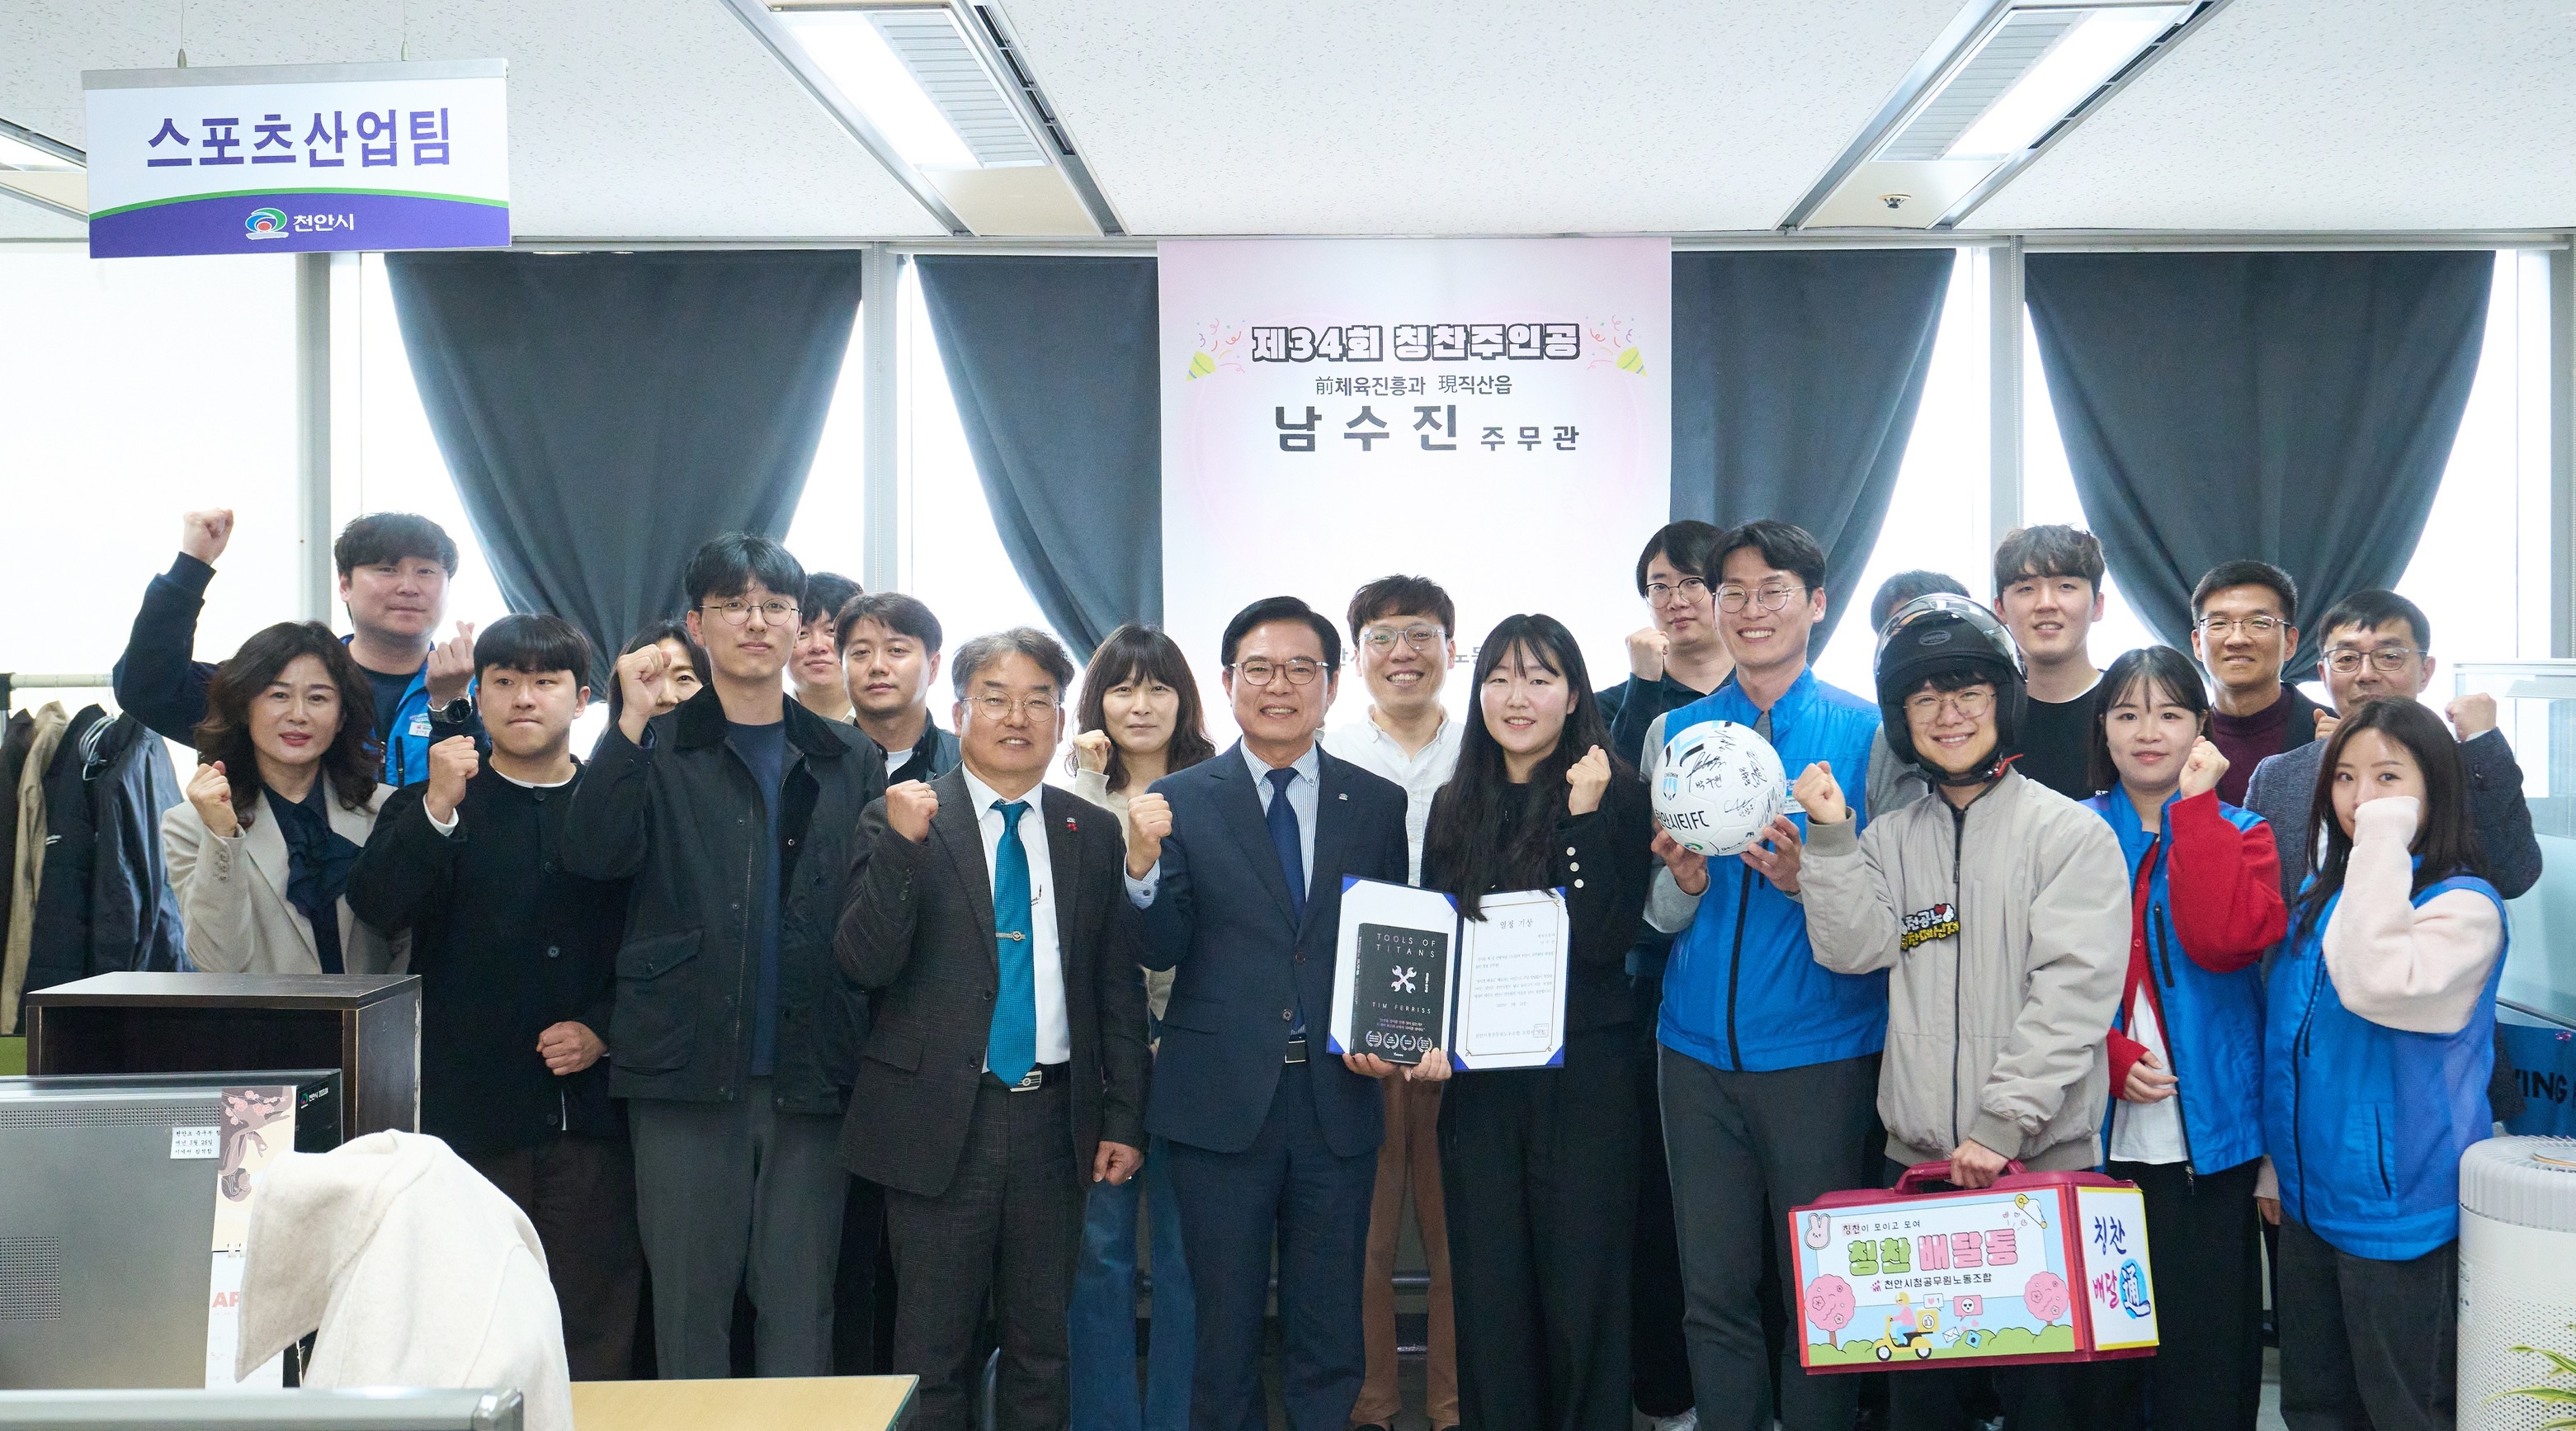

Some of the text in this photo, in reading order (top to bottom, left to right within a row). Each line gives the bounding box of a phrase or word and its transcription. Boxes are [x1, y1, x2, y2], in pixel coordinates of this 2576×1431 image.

[147, 108, 450, 168] 스포츠산업팀
[293, 213, 355, 234] 천안시
[1252, 323, 1581, 362] 제34회 칭찬주인공
[1315, 375, 1513, 397] 前체육진흥과 現직산읍
[1376, 933, 1436, 947] TOOLS OF
[1376, 943, 1435, 958] TITANS
[1394, 1004, 1432, 1014] FERRISS
[2515, 1069, 2568, 1104] ING
[1842, 1220, 1921, 1235] 칭찬이 모이고 모여
[2094, 1216, 2127, 1255] 칭찬
[1847, 1228, 2019, 1277] 칭찬 배달통
[1884, 1273, 1993, 1290] 천안시청공무원노동조합
